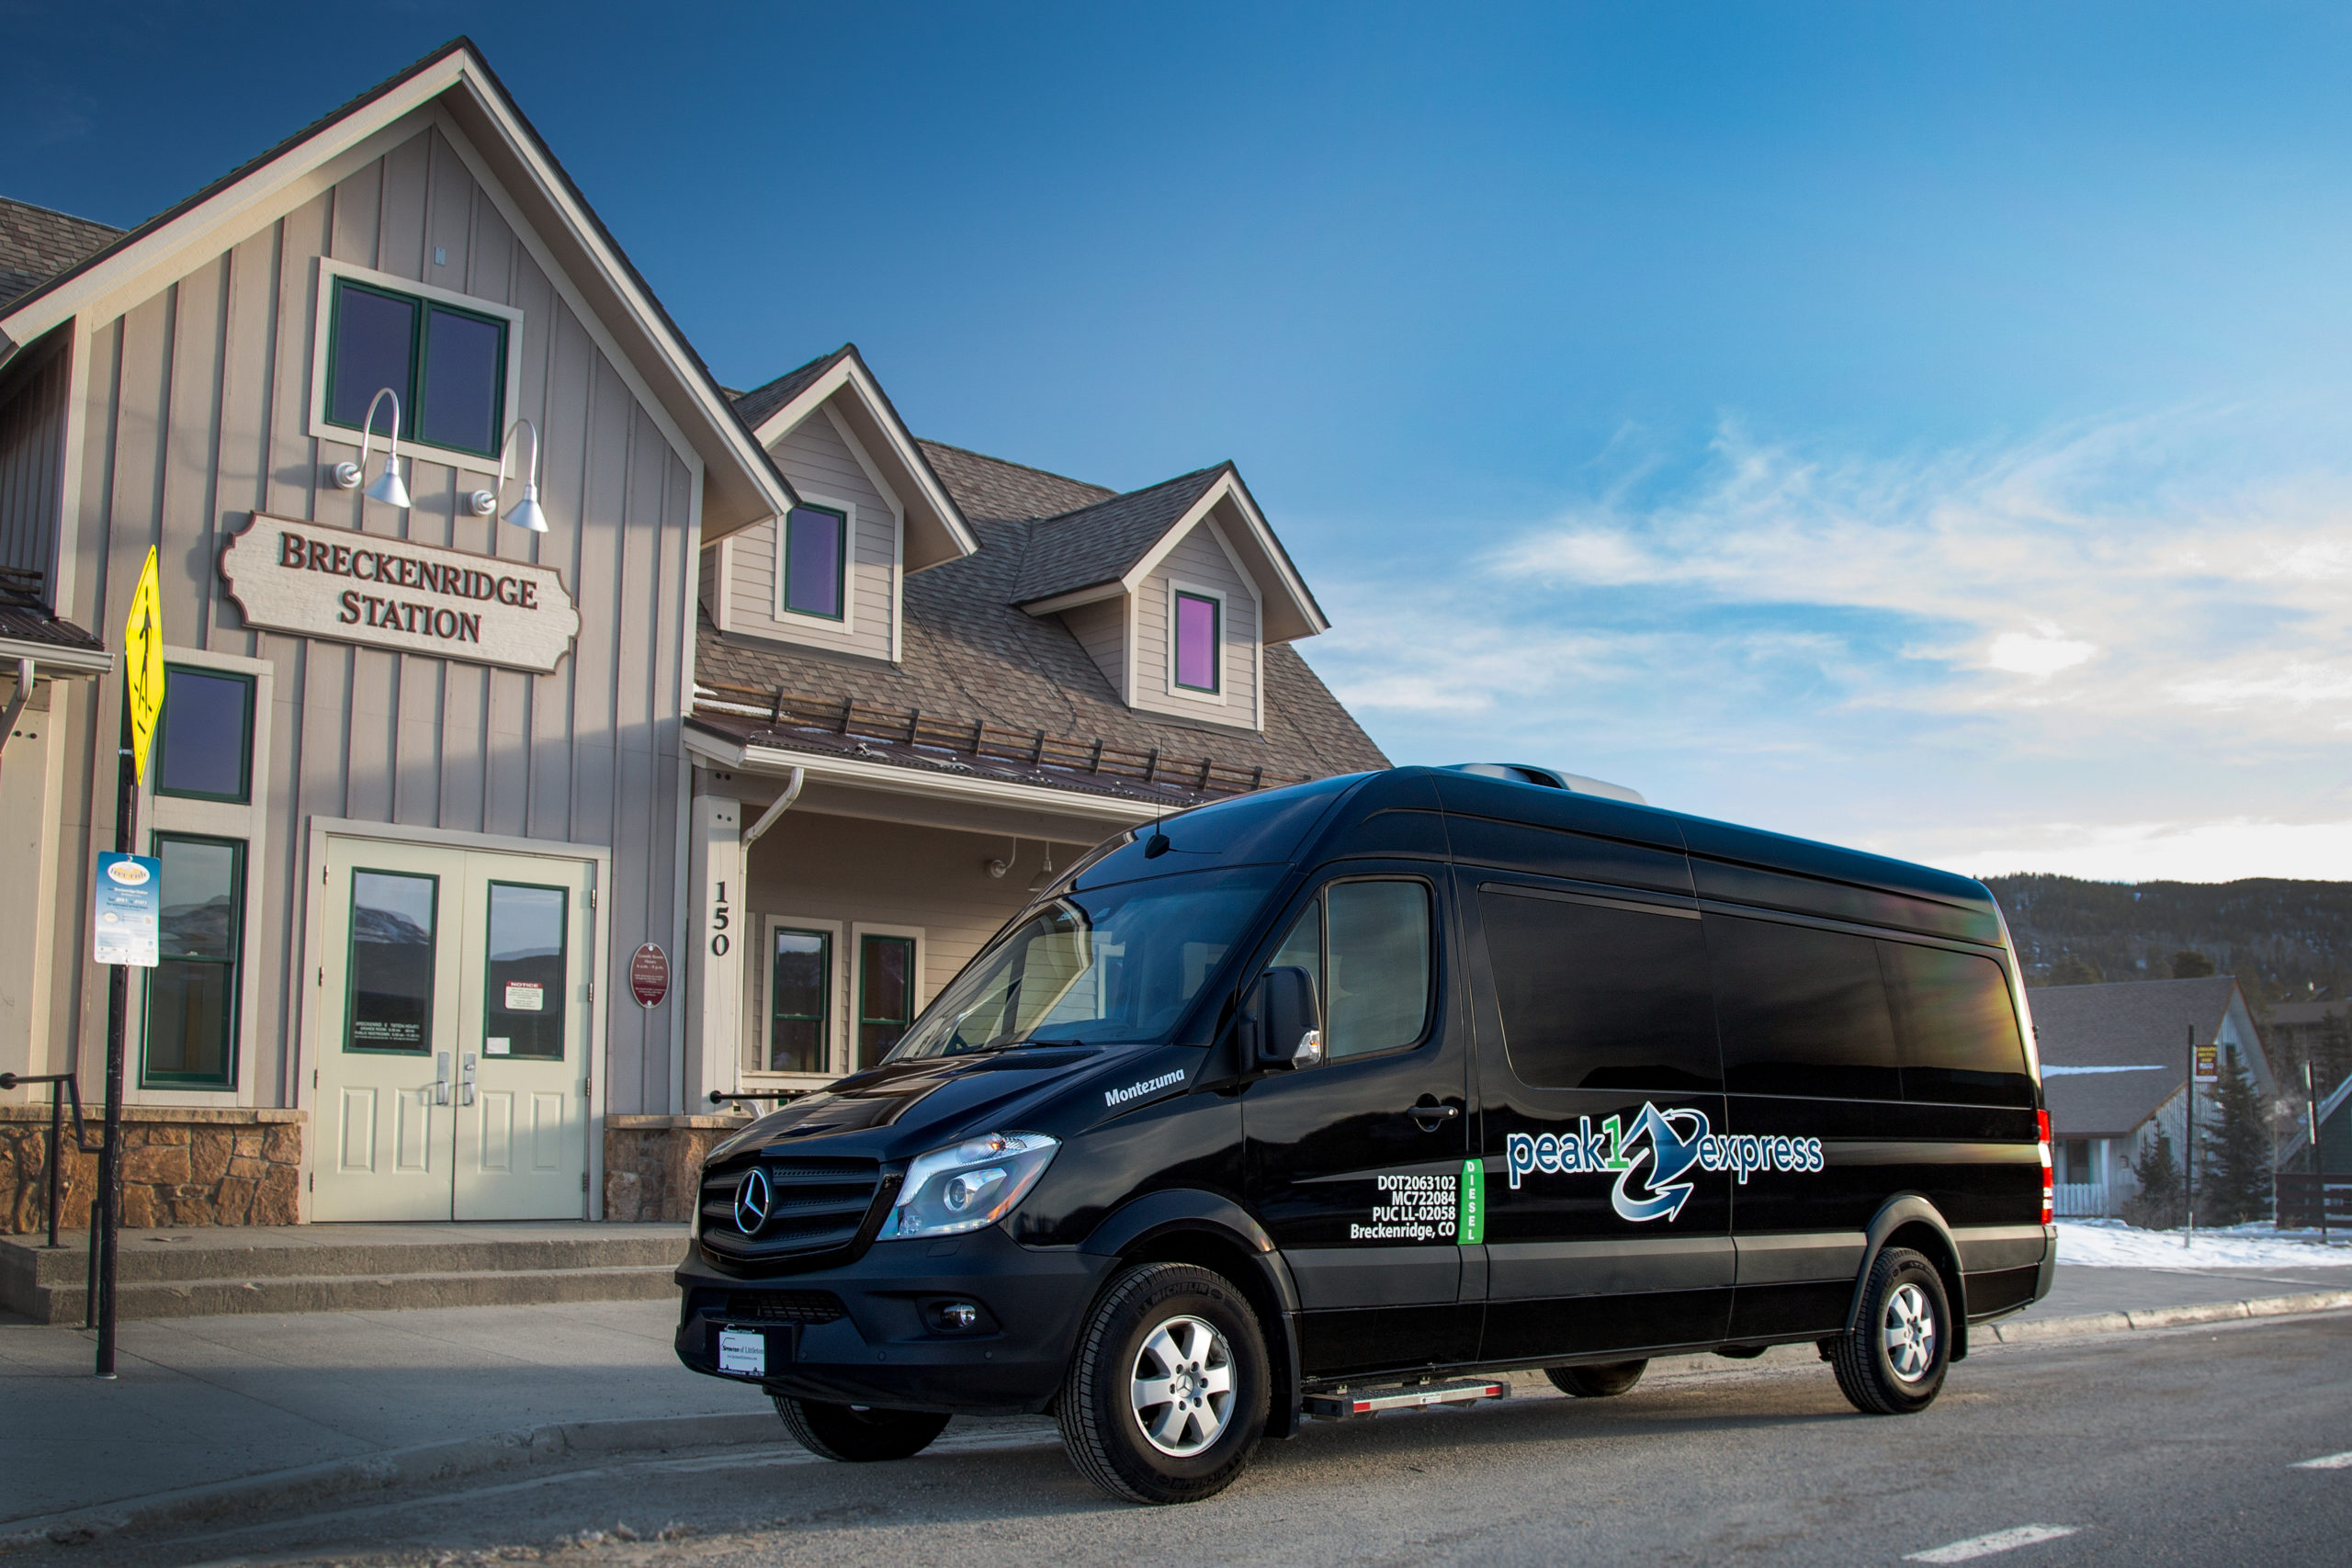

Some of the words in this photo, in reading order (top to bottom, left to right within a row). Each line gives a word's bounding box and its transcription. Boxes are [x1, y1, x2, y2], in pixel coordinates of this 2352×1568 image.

[279, 531, 538, 610] BRECKENRIDGE
[339, 590, 482, 644] STATION
[711, 881, 730, 957] 150
[1104, 1068, 1185, 1107] Montezuma
[1697, 1134, 1825, 1185] express
[1378, 1175, 1456, 1190] DOT2063102
[1392, 1191, 1455, 1205] MC722084
[1466, 1161, 1476, 1240] DIESEL
[1351, 1222, 1436, 1240] Breckenridge,
[1438, 1222, 1455, 1236] CO
[1373, 1207, 1399, 1222] PUC
[1401, 1206, 1455, 1221] LL-02058
